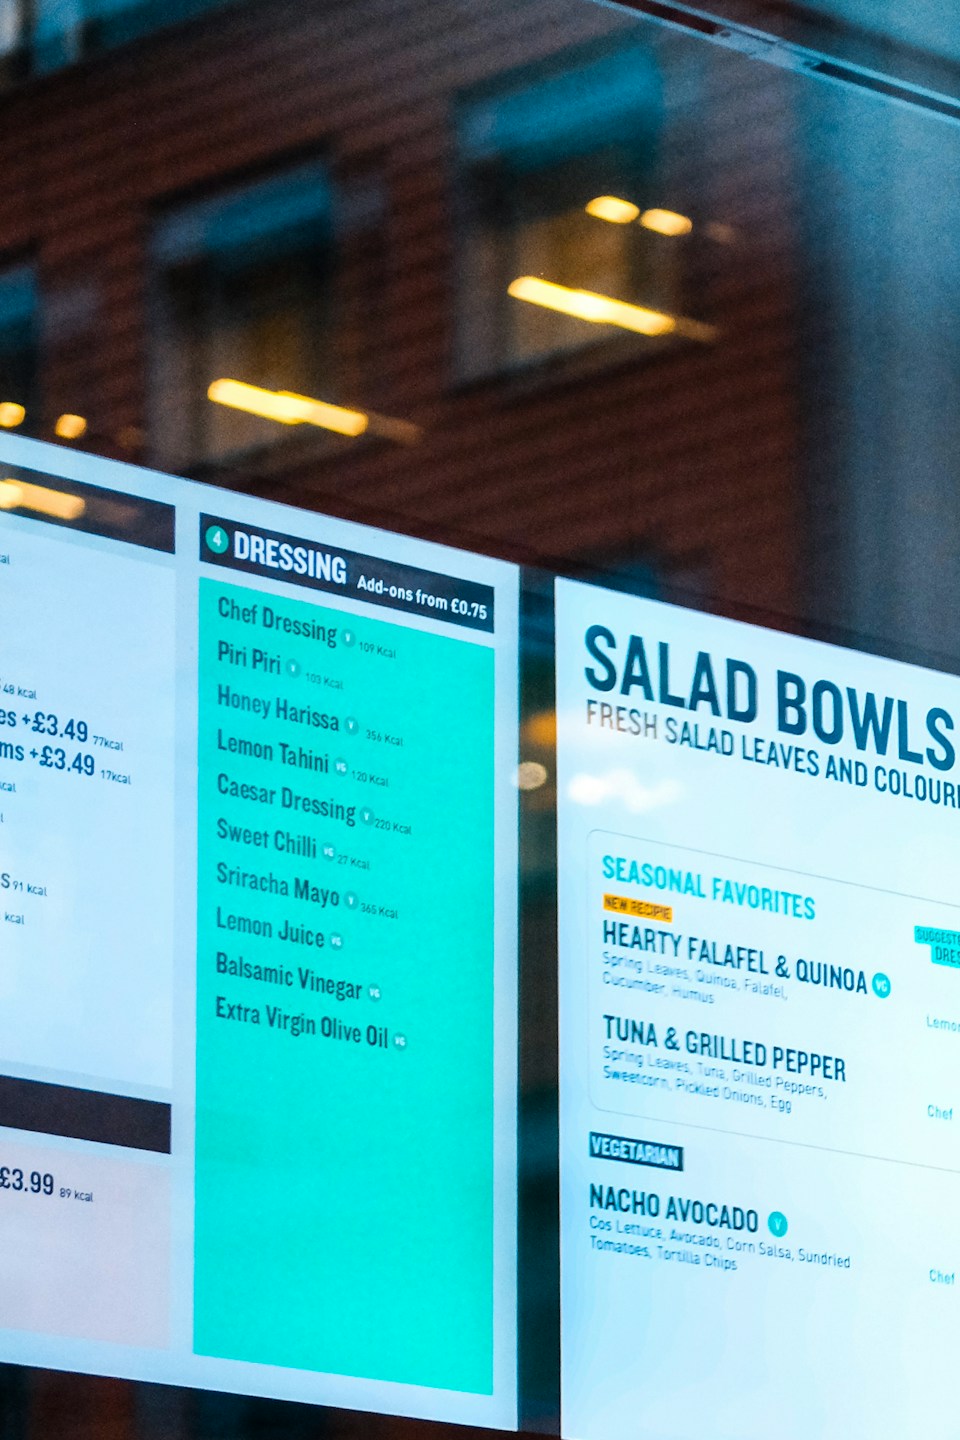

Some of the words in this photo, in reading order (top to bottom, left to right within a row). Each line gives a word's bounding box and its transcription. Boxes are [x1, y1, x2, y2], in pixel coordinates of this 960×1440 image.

[234, 530, 347, 584] DRESSING
[357, 575, 413, 602] Add-ons
[416, 589, 447, 611] from
[450, 598, 487, 620] £0.75
[218, 596, 258, 625] Chef
[262, 606, 337, 648] Dressing
[218, 640, 247, 667] Piri
[252, 648, 280, 675] Piri
[18, 686, 37, 700] kcal
[218, 684, 271, 719] Honey
[276, 697, 340, 732] Harissa
[585, 624, 758, 724] SALAD
[776, 669, 956, 772] BOWLS
[217, 728, 273, 761] Lemon
[278, 742, 329, 774] Tahini
[586, 700, 658, 741] FRESH
[665, 717, 735, 757] SALAD
[742, 735, 820, 778] LEAVES
[825, 755, 868, 788] AND
[217, 773, 276, 806] Caesar
[281, 787, 356, 827] Dressing
[217, 817, 269, 849] Sweet
[274, 830, 316, 859] Chilli
[13, 881, 23, 892] 91
[27, 883, 48, 897] kcal
[216, 862, 289, 897] Sriracha
[294, 877, 340, 909] Mayo
[603, 855, 706, 899] SEASONAL
[713, 877, 816, 920] FAVORITES
[4, 911, 25, 925] kcal
[216, 906, 272, 938] Lemon
[278, 920, 325, 948] Juice
[216, 952, 293, 987] Balsamic
[298, 967, 363, 1001] Vinegar
[603, 920, 682, 957] HEARTY
[688, 936, 768, 975] FALAFEL
[775, 955, 790, 979] &
[796, 959, 867, 994] QUINOA
[216, 996, 260, 1025] Extra
[266, 1005, 316, 1038] Virgin
[321, 1016, 362, 1044] Olive
[366, 1025, 388, 1049] Oil
[603, 1015, 657, 1047] TUNA
[664, 1027, 680, 1051] &
[686, 1031, 766, 1067] GRILLED
[773, 1046, 845, 1081] PEPPER
[603, 1046, 643, 1067] Spring
[733, 1070, 772, 1088] Grilled
[776, 1077, 827, 1100] Peppers,
[928, 1105, 953, 1120] Chef
[592, 1136, 679, 1167] VEGETARIAN
[59, 1187, 71, 1199] 89
[74, 1189, 93, 1202] kcal
[590, 1183, 660, 1217] NACHO
[666, 1197, 758, 1233] AVOCADO
[590, 1216, 612, 1231] Cos
[727, 1238, 755, 1253] Corn
[759, 1242, 794, 1261] Salsa,
[799, 1248, 850, 1268] Sundried
[930, 1269, 955, 1285] Chef
